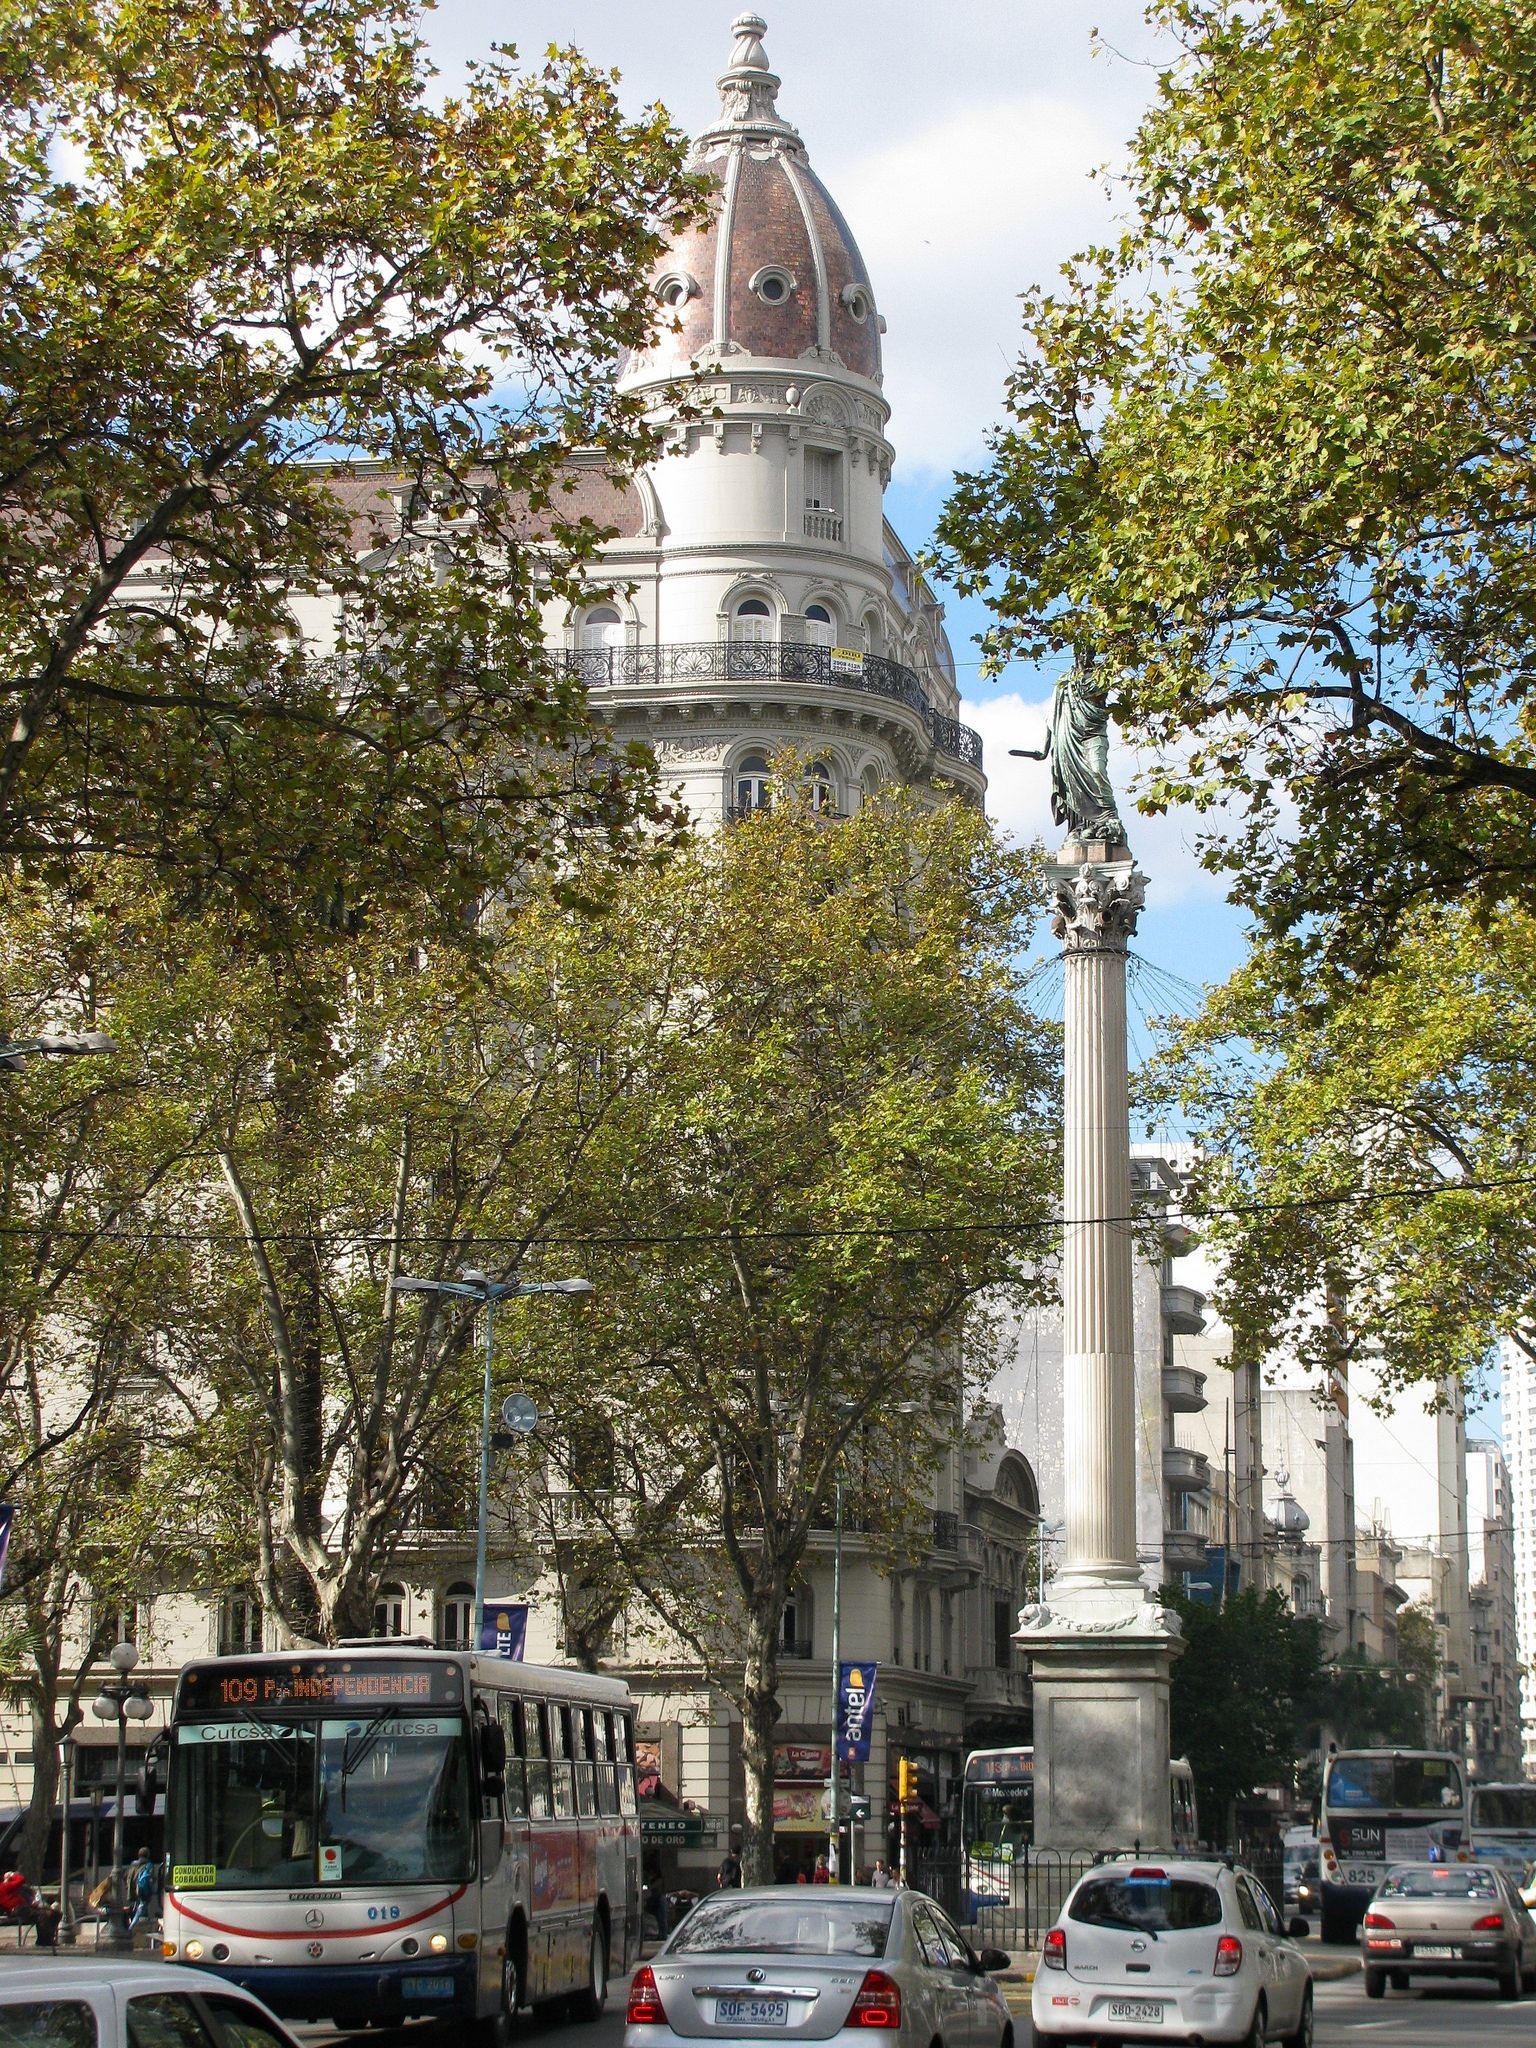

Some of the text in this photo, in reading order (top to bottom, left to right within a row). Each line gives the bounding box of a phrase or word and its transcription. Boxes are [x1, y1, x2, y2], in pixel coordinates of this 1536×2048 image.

[497, 1632, 512, 1656] LTE
[220, 1678, 258, 1703] 109
[293, 1675, 430, 1697] INDEPENDENCIA
[845, 1687, 865, 1742] antel
[200, 1725, 272, 1741] Cutcsa
[365, 1720, 439, 1737] Cutcsa
[652, 1835, 664, 1844] DE
[667, 1835, 685, 1844] ORO
[1352, 1828, 1379, 1841] SUN
[174, 1866, 214, 1875] CONDUCTOR
[1349, 1870, 1375, 1883] 825
[174, 1875, 214, 1884] COBRADOR
[290, 1892, 342, 1901] Marcopolo
[368, 1906, 400, 1920] 018
